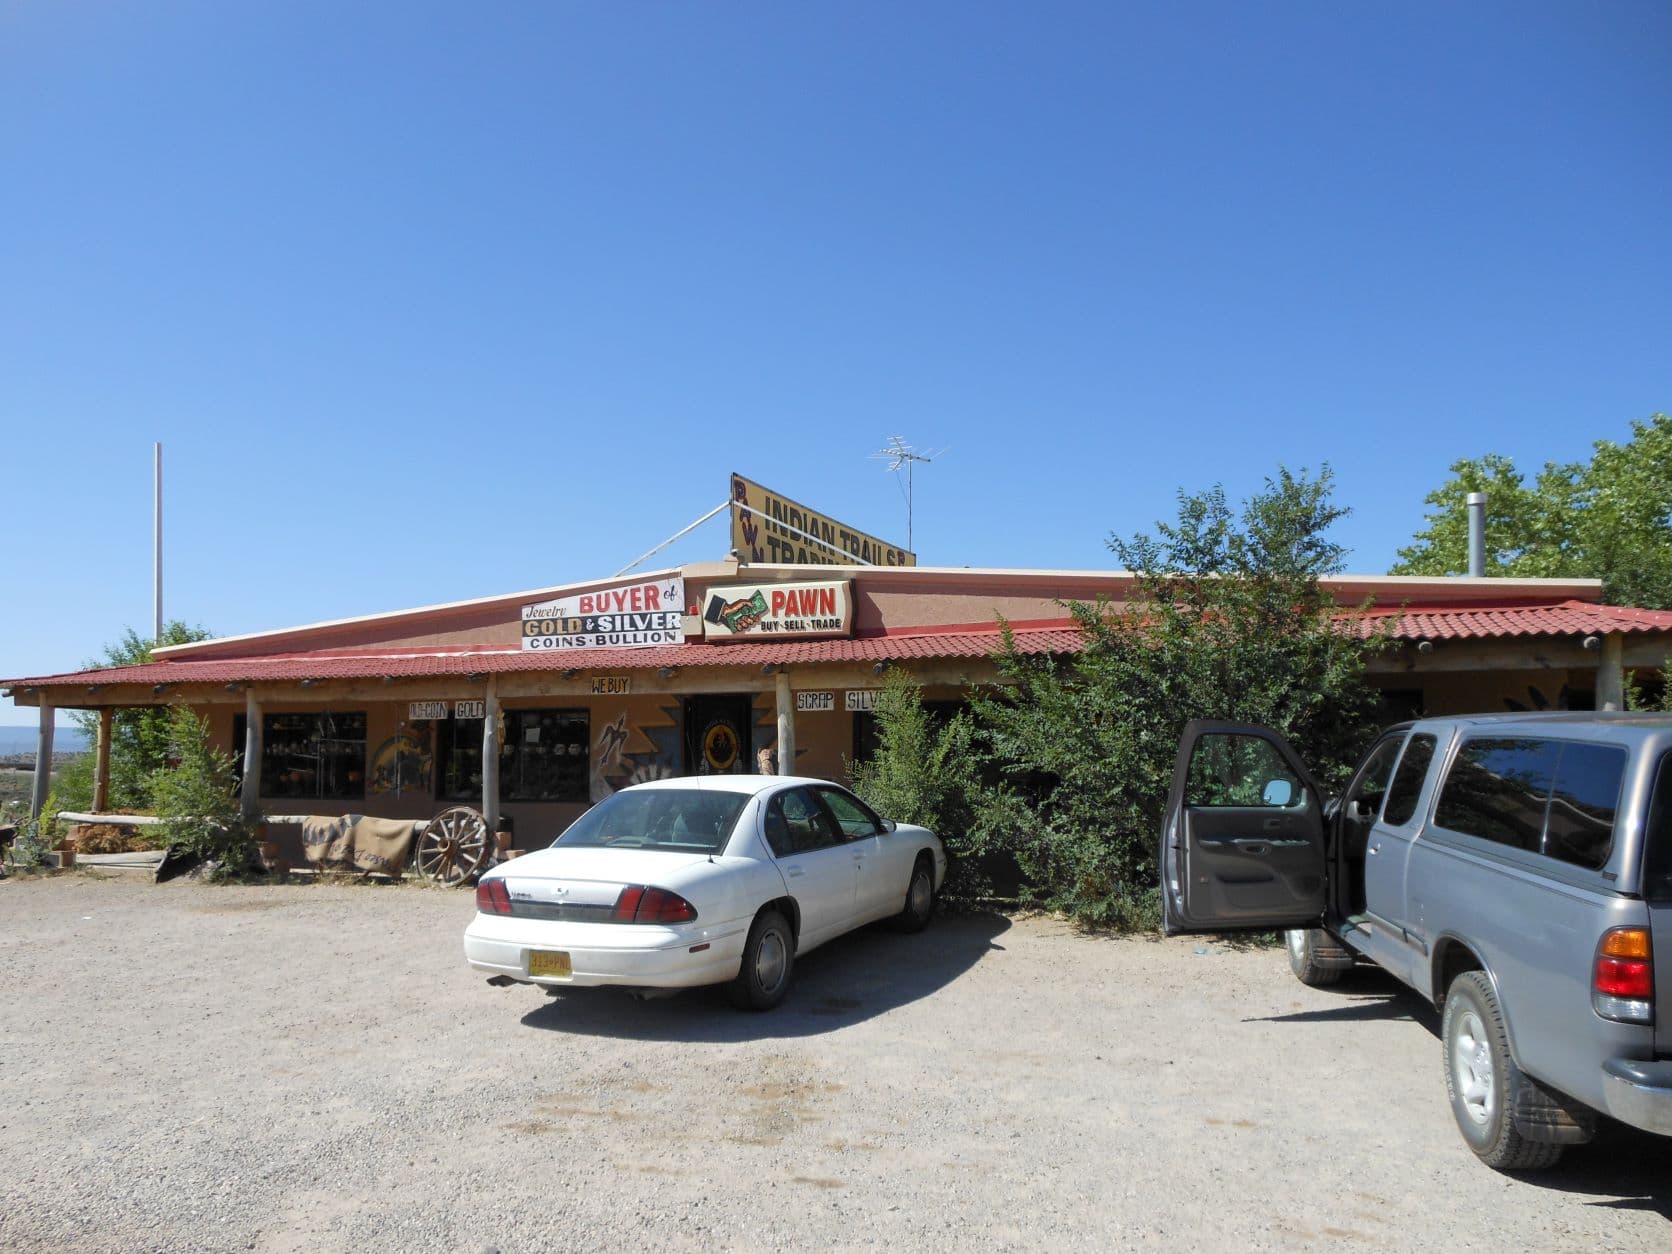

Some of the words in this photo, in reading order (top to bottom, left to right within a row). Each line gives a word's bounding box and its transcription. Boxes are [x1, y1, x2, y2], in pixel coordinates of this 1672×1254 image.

[765, 496, 835, 556] INDIAN
[526, 606, 566, 618] Jewelry
[579, 585, 660, 613] BUYER
[663, 585, 677, 601] of
[772, 588, 836, 617] PAWN
[525, 618, 582, 636] GOLD
[586, 618, 594, 631] &
[598, 612, 681, 632] SILVER
[761, 621, 779, 631] BUY
[784, 620, 805, 630] SELL
[811, 619, 841, 629] TRADE
[530, 636, 586, 648] COINS
[595, 631, 676, 646] BULLION
[607, 678, 628, 693] BUY
[798, 693, 833, 709] SCRAP
[847, 691, 886, 709] SILV
[457, 703, 485, 717] GOLD
